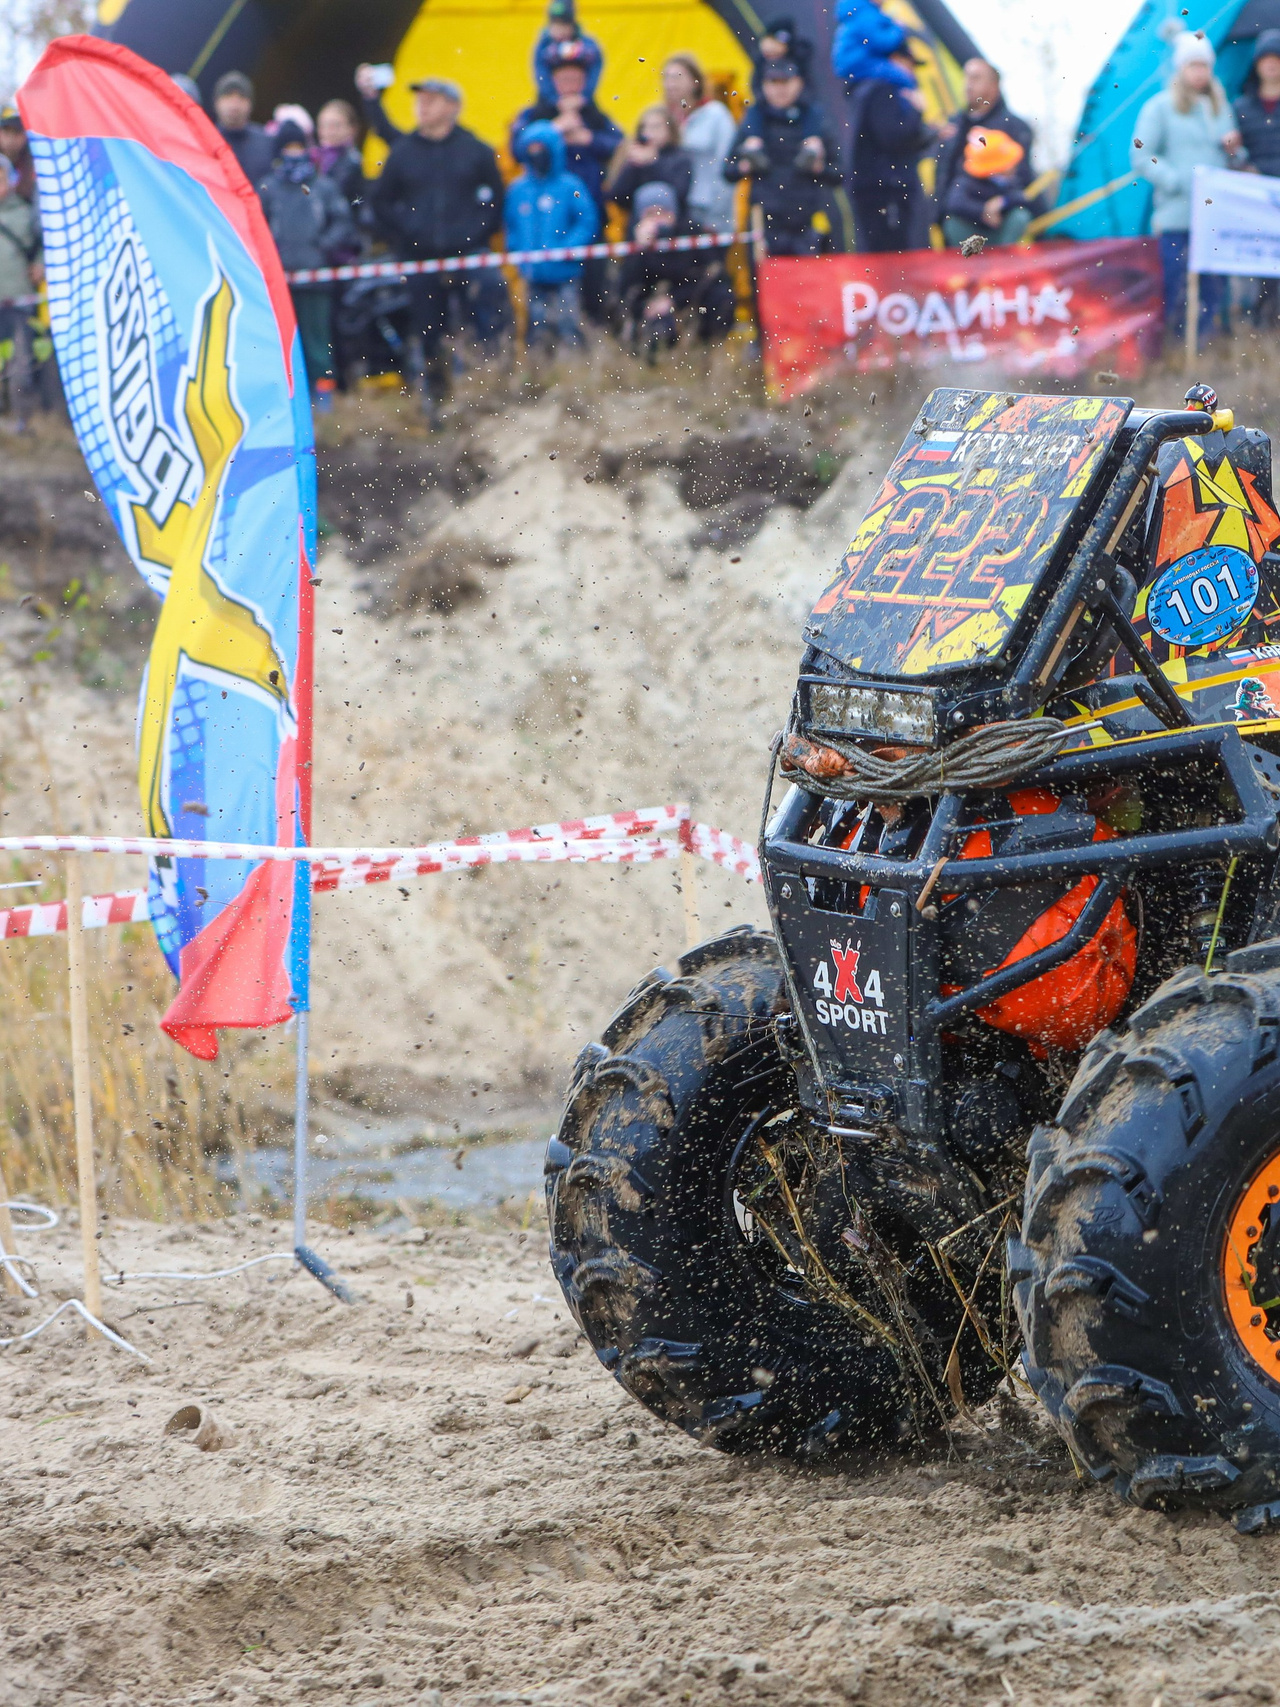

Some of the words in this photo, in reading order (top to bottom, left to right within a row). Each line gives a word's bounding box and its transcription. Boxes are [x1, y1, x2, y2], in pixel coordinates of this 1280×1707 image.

[843, 487, 1048, 609] 222
[1165, 563, 1240, 626] 101
[813, 946, 885, 1008] 4X4
[816, 999, 889, 1035] SPORT
